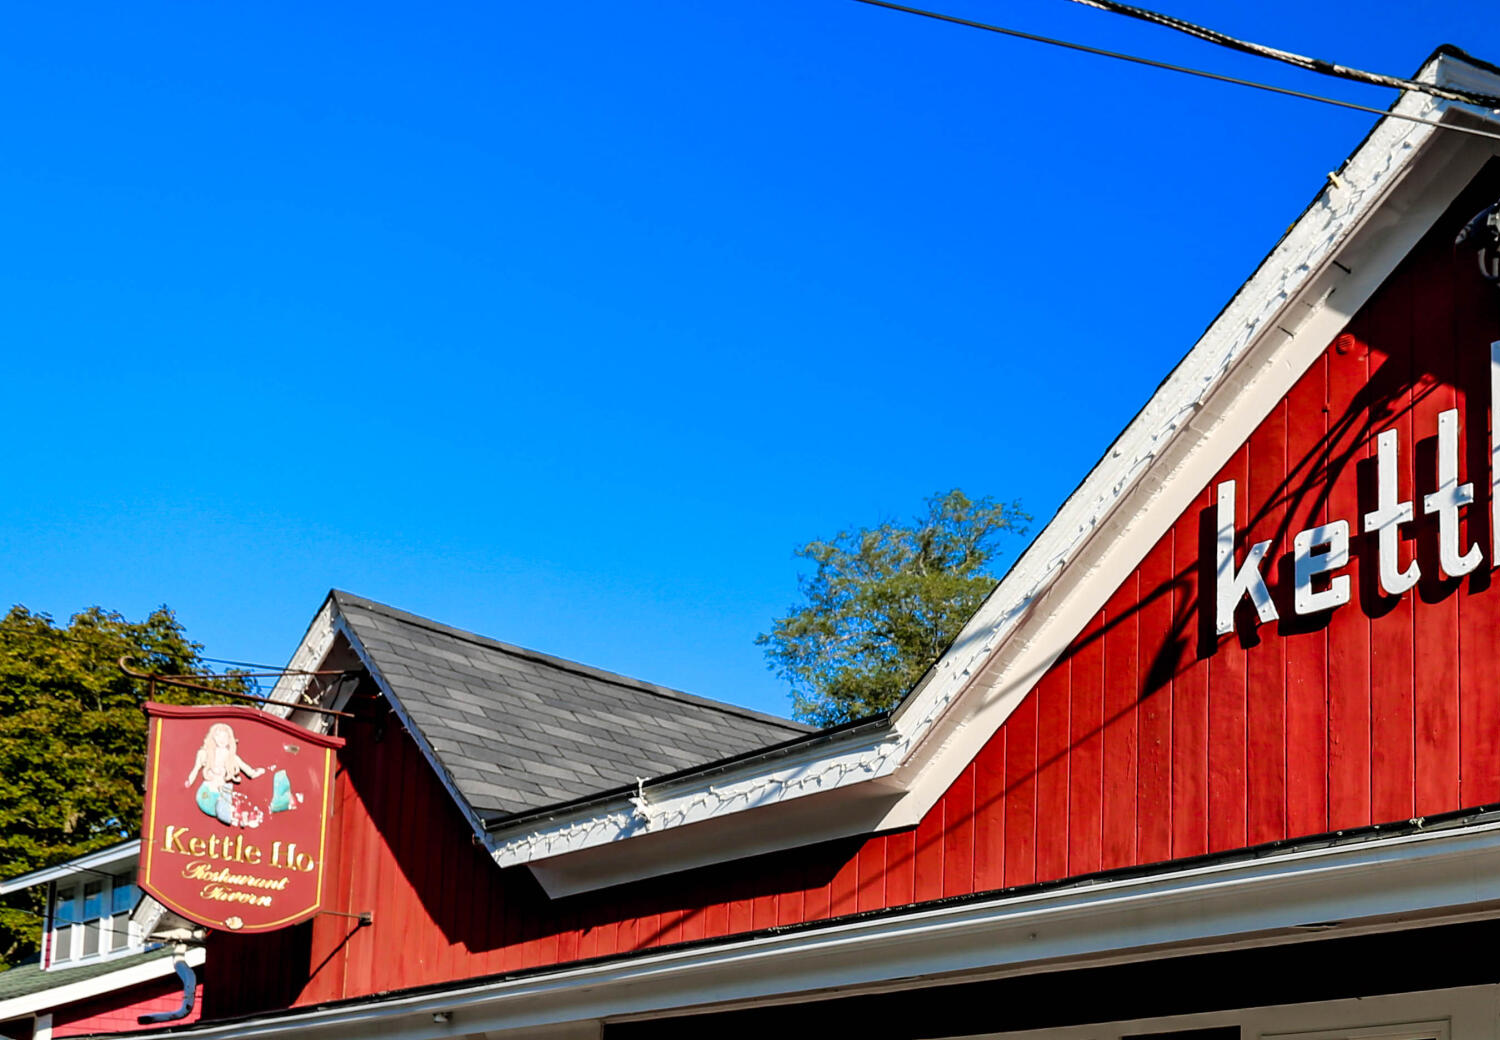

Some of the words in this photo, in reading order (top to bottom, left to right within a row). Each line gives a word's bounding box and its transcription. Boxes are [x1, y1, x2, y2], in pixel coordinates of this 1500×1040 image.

[160, 824, 262, 865] Kettle
[268, 841, 315, 873] Ho
[181, 859, 290, 891] Restaurant
[199, 882, 273, 907] Tavern
